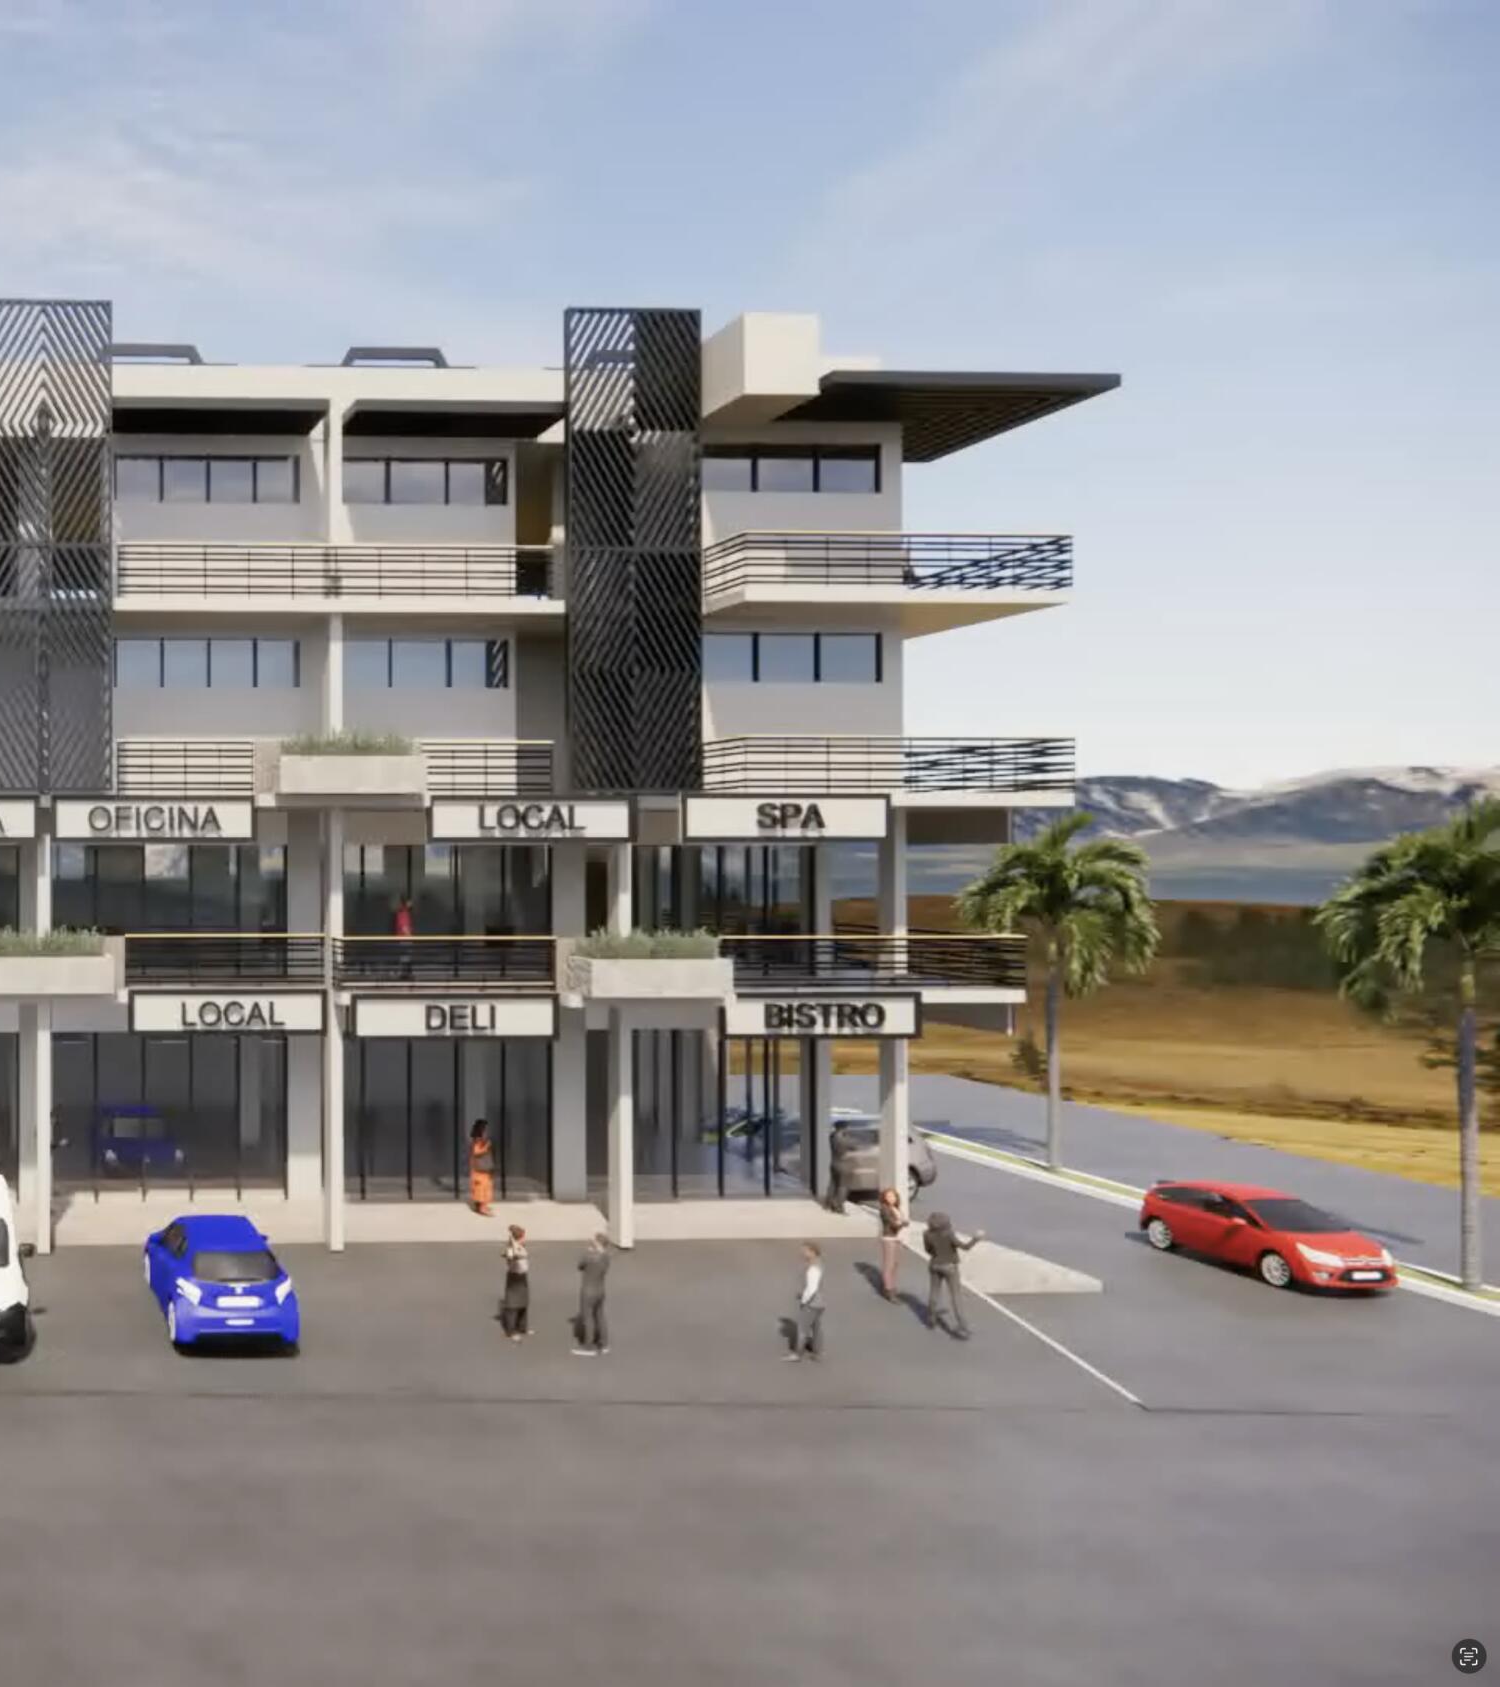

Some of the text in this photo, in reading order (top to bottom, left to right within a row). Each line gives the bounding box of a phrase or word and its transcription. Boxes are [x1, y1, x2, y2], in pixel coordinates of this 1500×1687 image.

[88, 805, 222, 832] OFICINA
[478, 803, 586, 831] LOCAL
[756, 802, 826, 830] SPA
[181, 1001, 286, 1027] LOCAL
[425, 1004, 496, 1031] DELI
[763, 1002, 887, 1030] BISTRO
